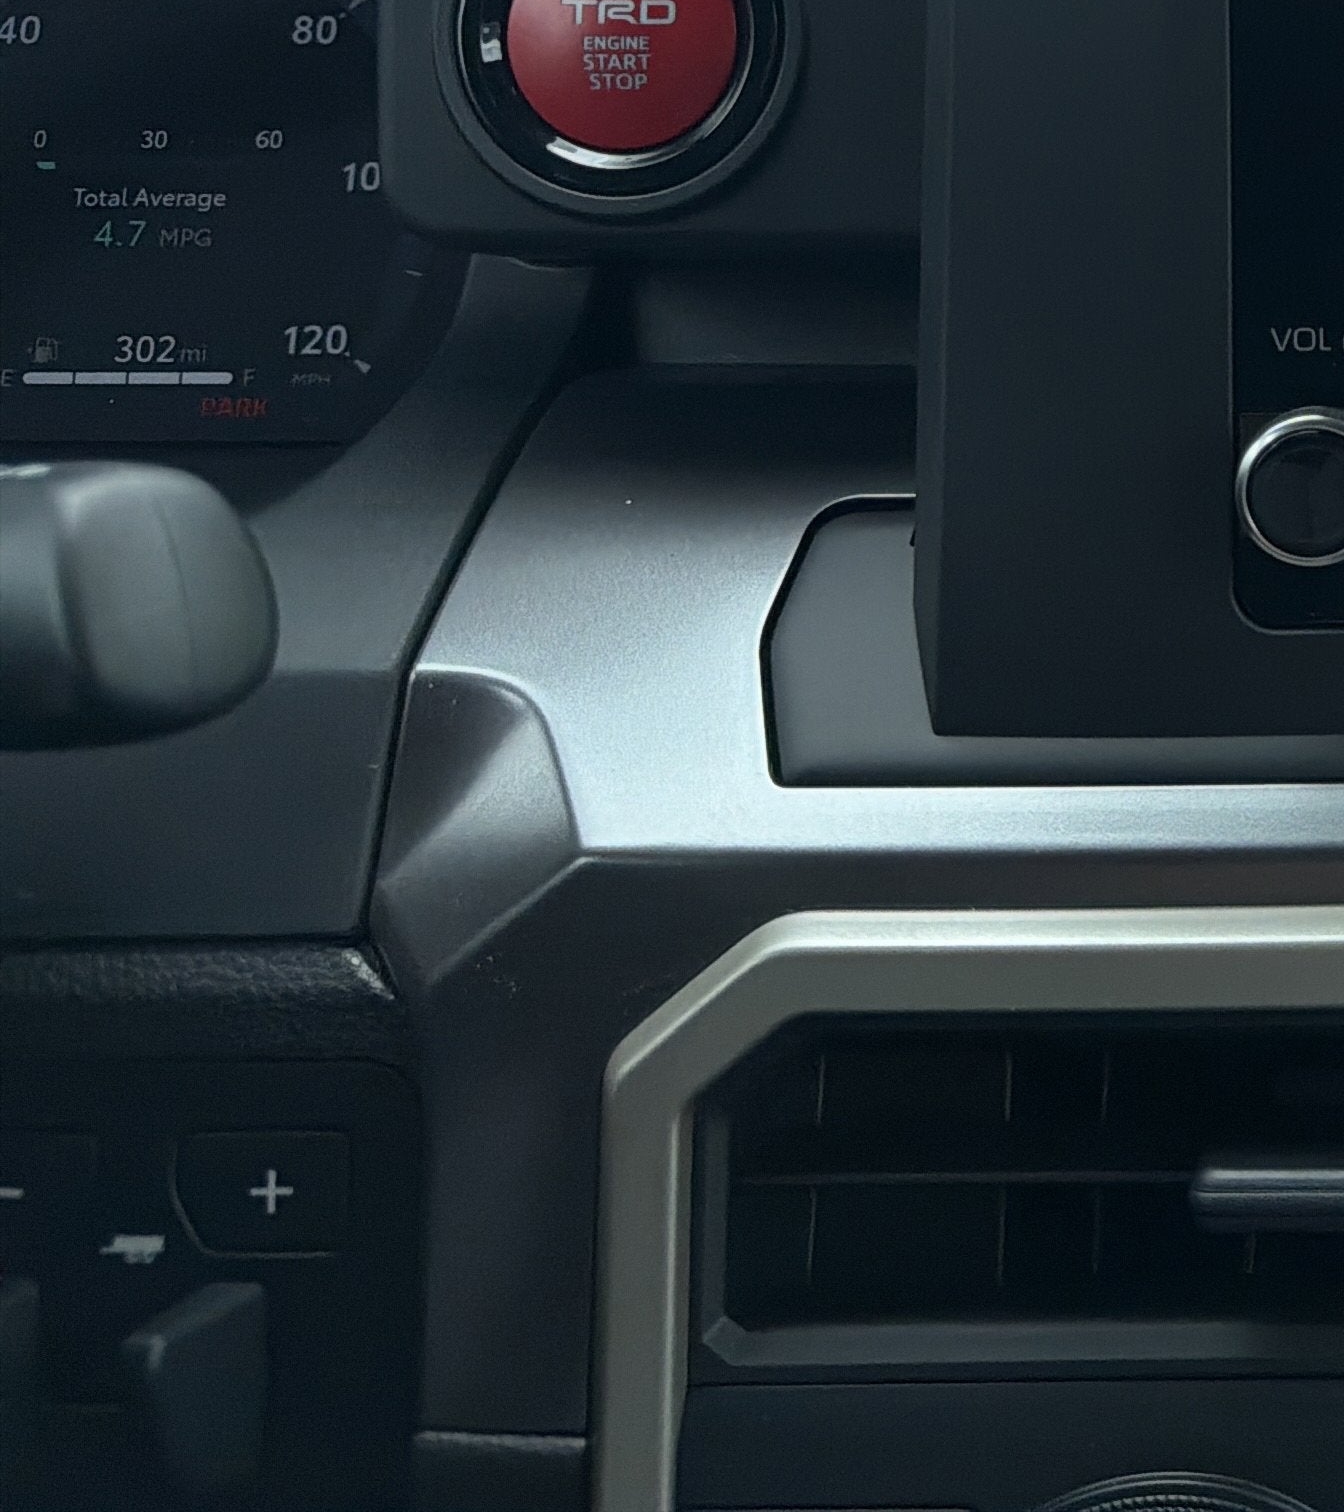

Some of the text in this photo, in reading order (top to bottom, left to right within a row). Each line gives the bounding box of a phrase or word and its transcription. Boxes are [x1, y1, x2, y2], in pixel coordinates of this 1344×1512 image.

[0, 15, 41, 45] 40
[291, 15, 338, 45] 80
[583, 36, 651, 51] ENGINE
[583, 54, 651, 71] START
[589, 73, 648, 91] STOP
[33, 129, 47, 149] 0
[140, 129, 168, 149] 30
[255, 129, 283, 149] 60
[343, 161, 380, 192] 10
[73, 187, 227, 212] Total Average
[94, 220, 212, 248] 4.7 MPG
[113, 335, 207, 363] 302 mi
[284, 324, 348, 356] 120
[1270, 327, 1332, 352] VOL
